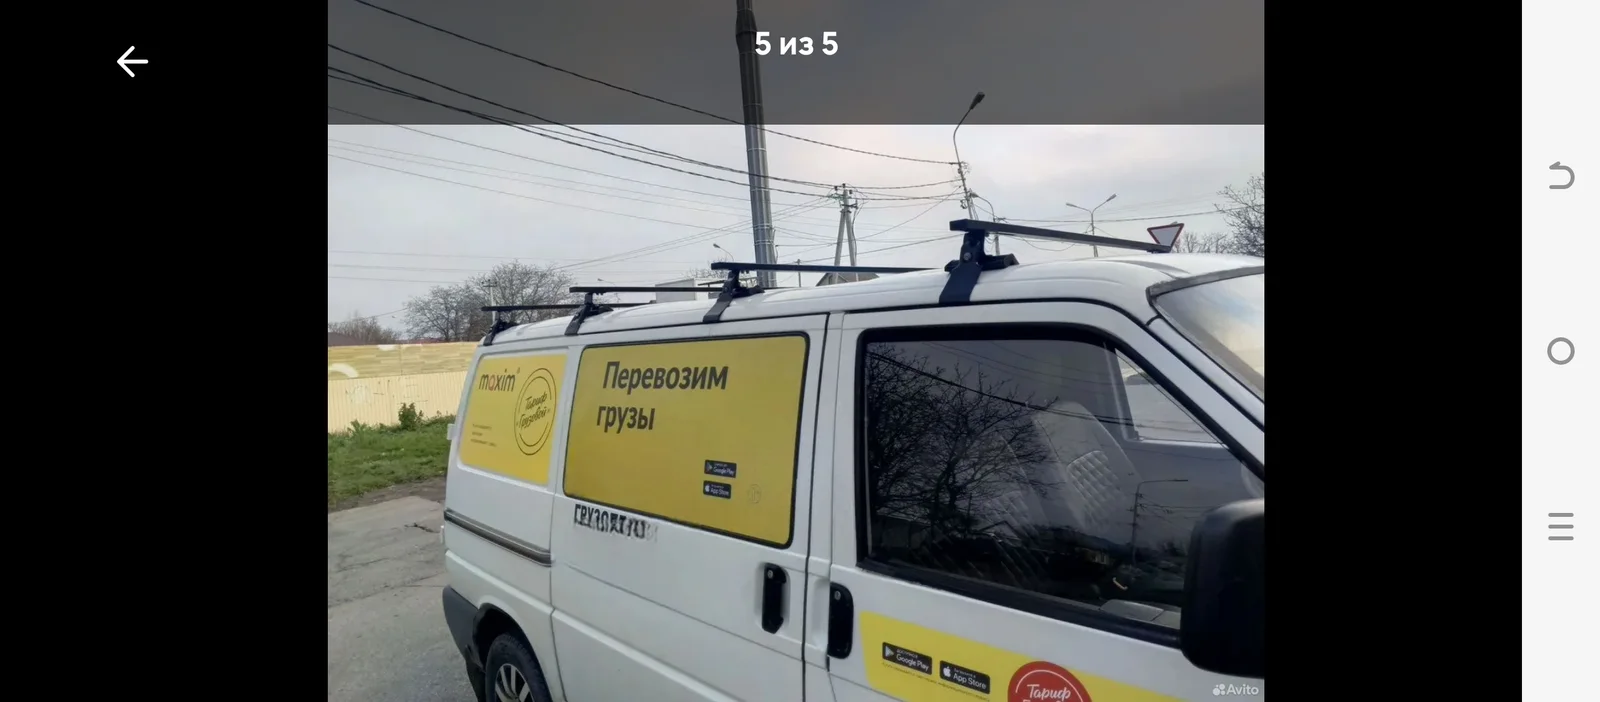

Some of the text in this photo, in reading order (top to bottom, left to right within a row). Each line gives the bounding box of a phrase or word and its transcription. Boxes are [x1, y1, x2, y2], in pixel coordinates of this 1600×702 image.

[478, 368, 516, 392] maxim
[603, 361, 729, 395] Перевозим
[597, 405, 655, 434] грузы
[896, 653, 917, 667] Google
[917, 660, 930, 672] Play
[953, 673, 968, 685] App
[968, 677, 987, 690] Store
[1027, 684, 1071, 702] Тариф
